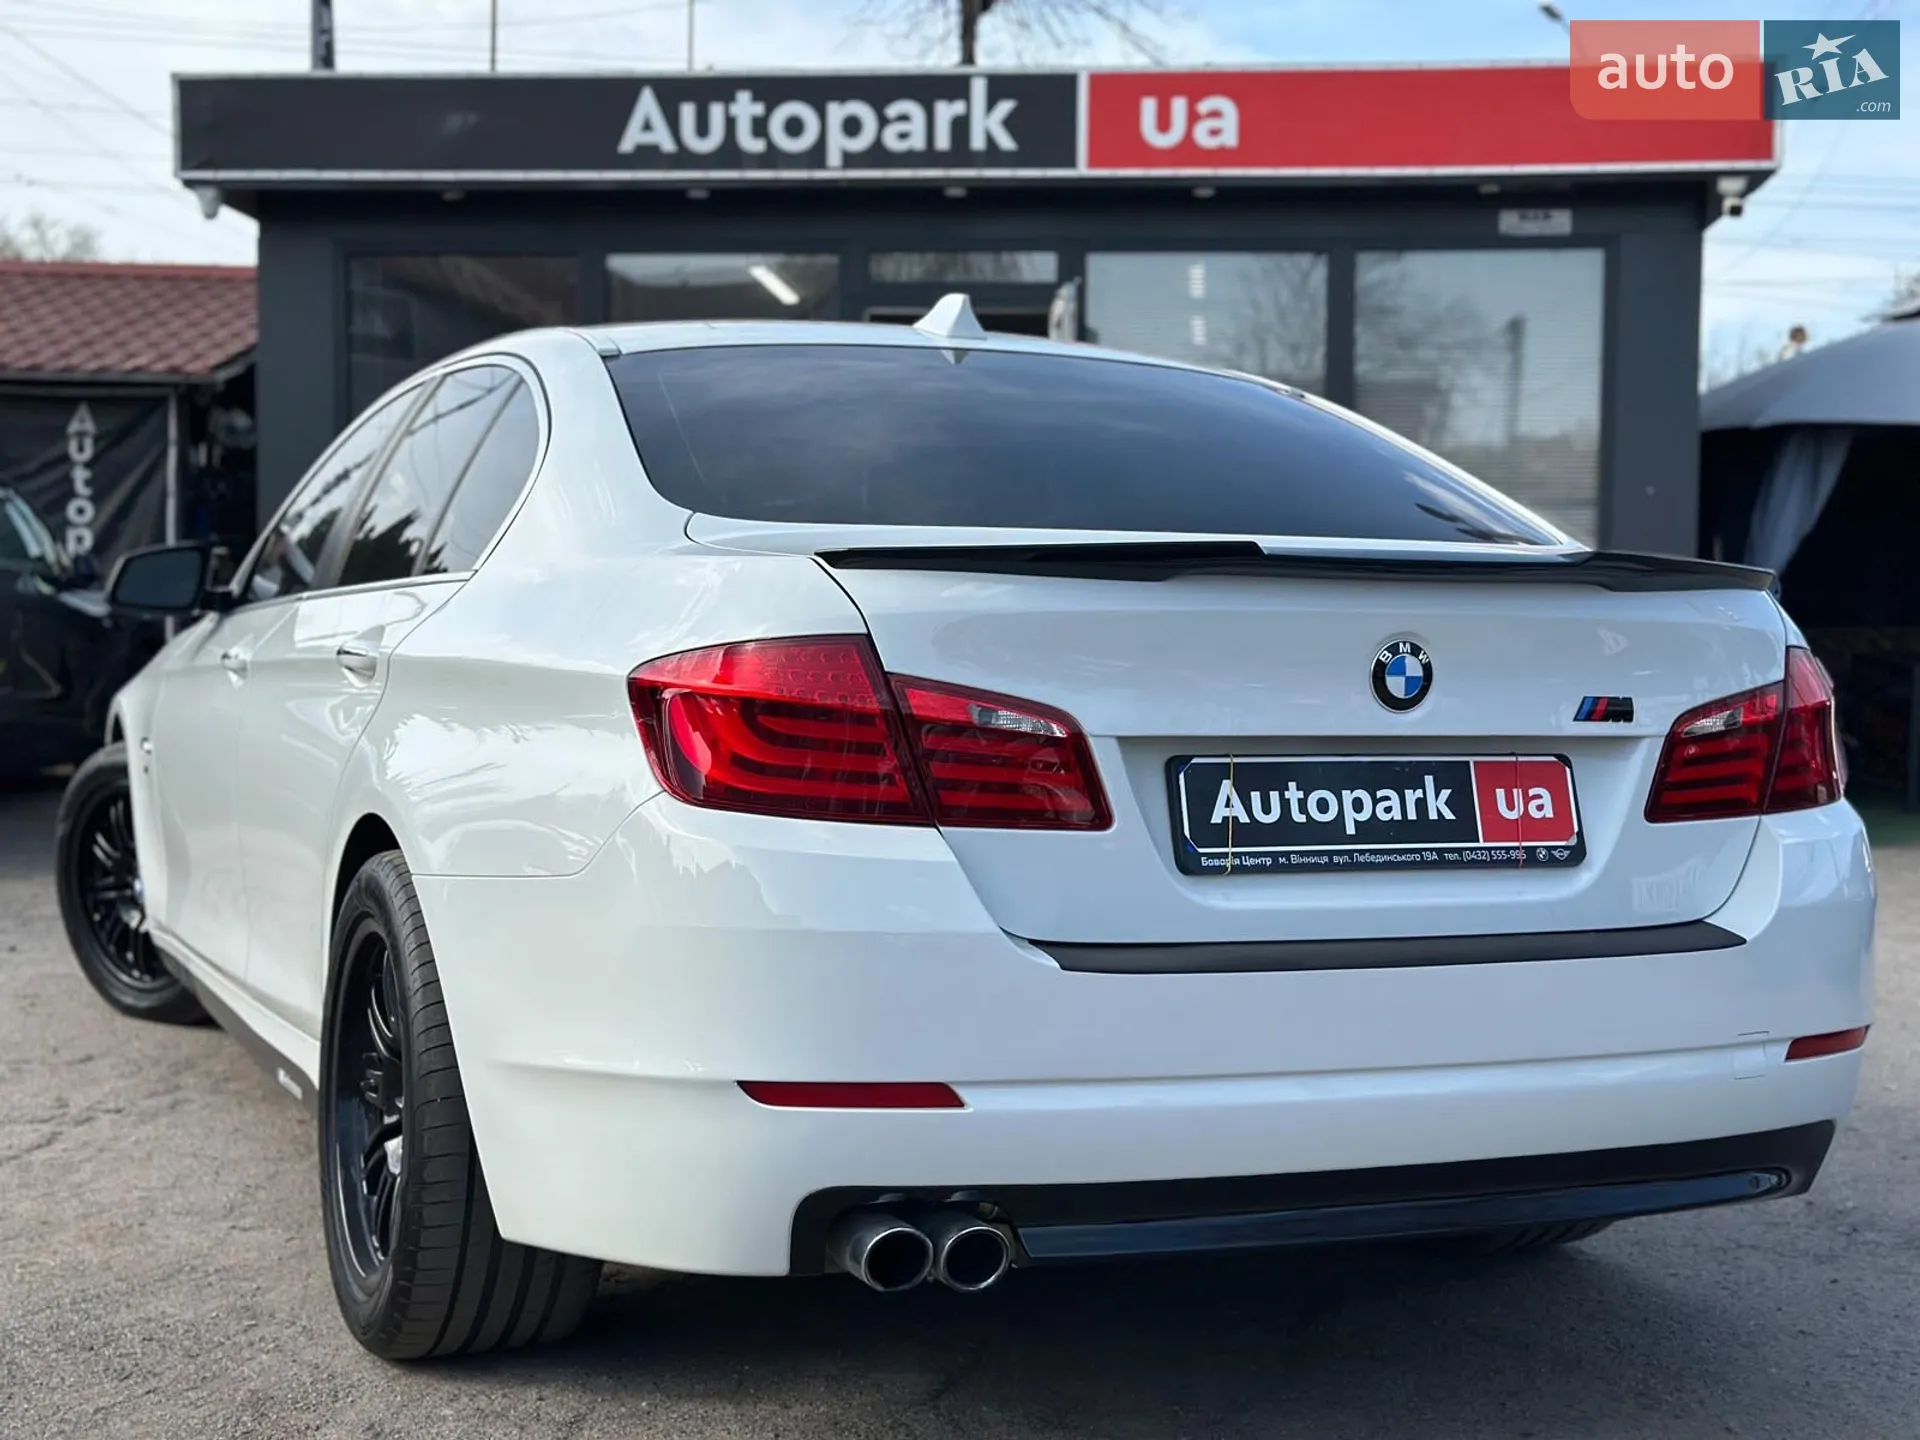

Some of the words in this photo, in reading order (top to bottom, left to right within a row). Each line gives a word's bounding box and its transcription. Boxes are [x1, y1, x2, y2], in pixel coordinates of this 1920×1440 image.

[617, 75, 1019, 169] Autopark
[1138, 94, 1240, 150] ua
[1378, 642, 1430, 665] BMW
[1210, 775, 1457, 836] Autopark
[1494, 787, 1556, 820] ua
[1242, 855, 1273, 867] Центр
[1290, 854, 1329, 865] Вінниця
[1462, 849, 1491, 862] (0432)
